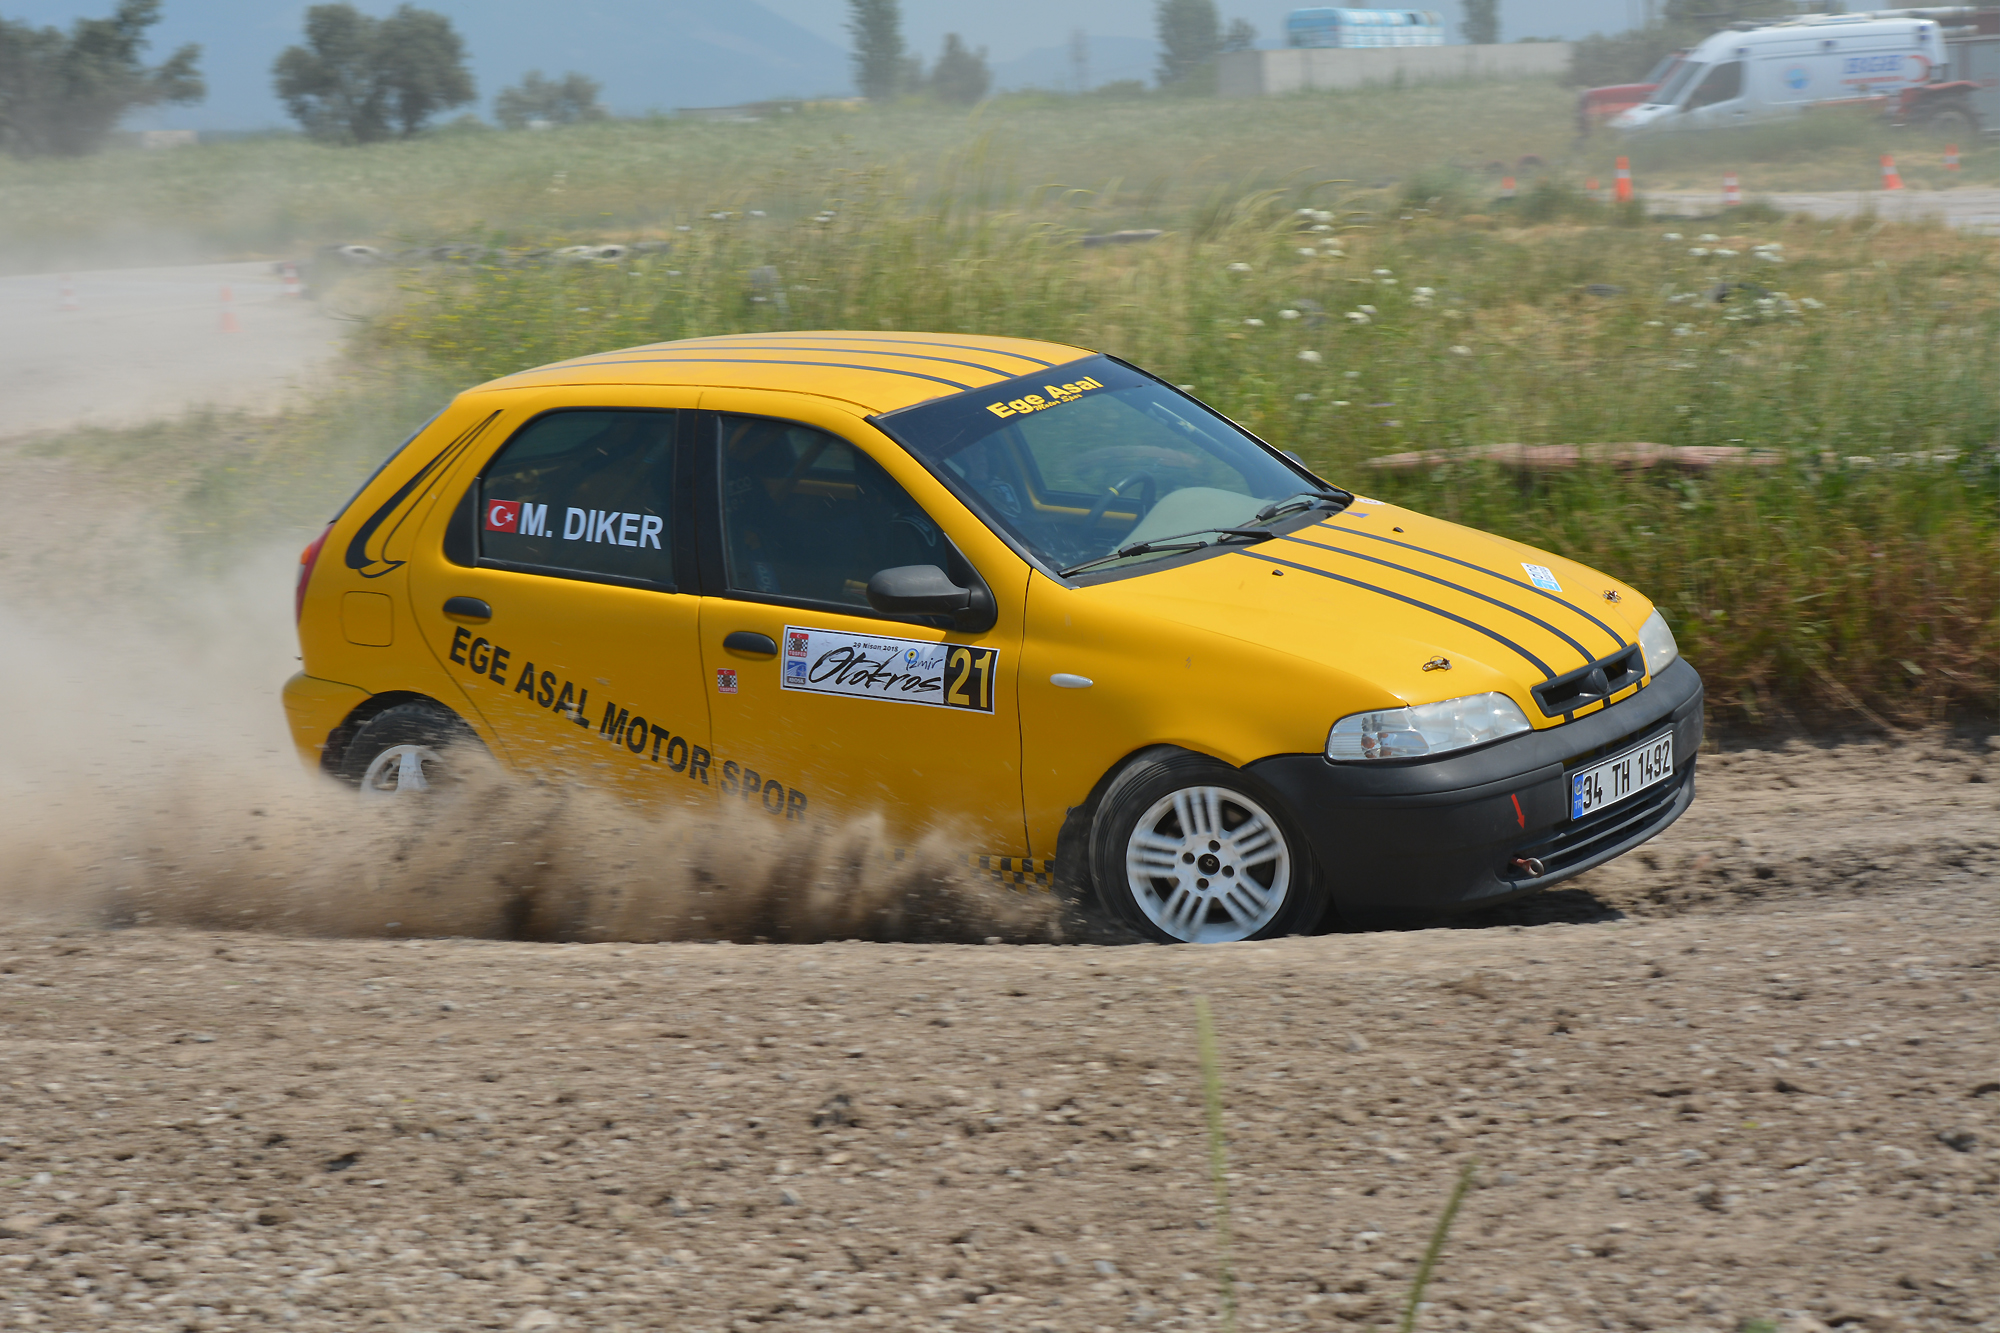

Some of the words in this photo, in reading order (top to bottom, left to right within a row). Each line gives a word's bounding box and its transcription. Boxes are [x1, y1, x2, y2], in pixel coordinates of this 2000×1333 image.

[986, 394, 1045, 419] Ege
[1043, 376, 1104, 399] Asal
[519, 502, 553, 538] M.
[562, 506, 664, 550] DIKER
[808, 646, 941, 693] Otokros
[862, 642, 882, 650] Nisan
[947, 648, 992, 708] 21
[449, 626, 511, 686] EGE
[514, 662, 590, 729] ASAL
[599, 701, 711, 786] MOTOR
[720, 760, 808, 824] SPOR
[1583, 771, 1603, 809] 34
[1612, 758, 1630, 798] TH
[1638, 740, 1671, 785] 1492
